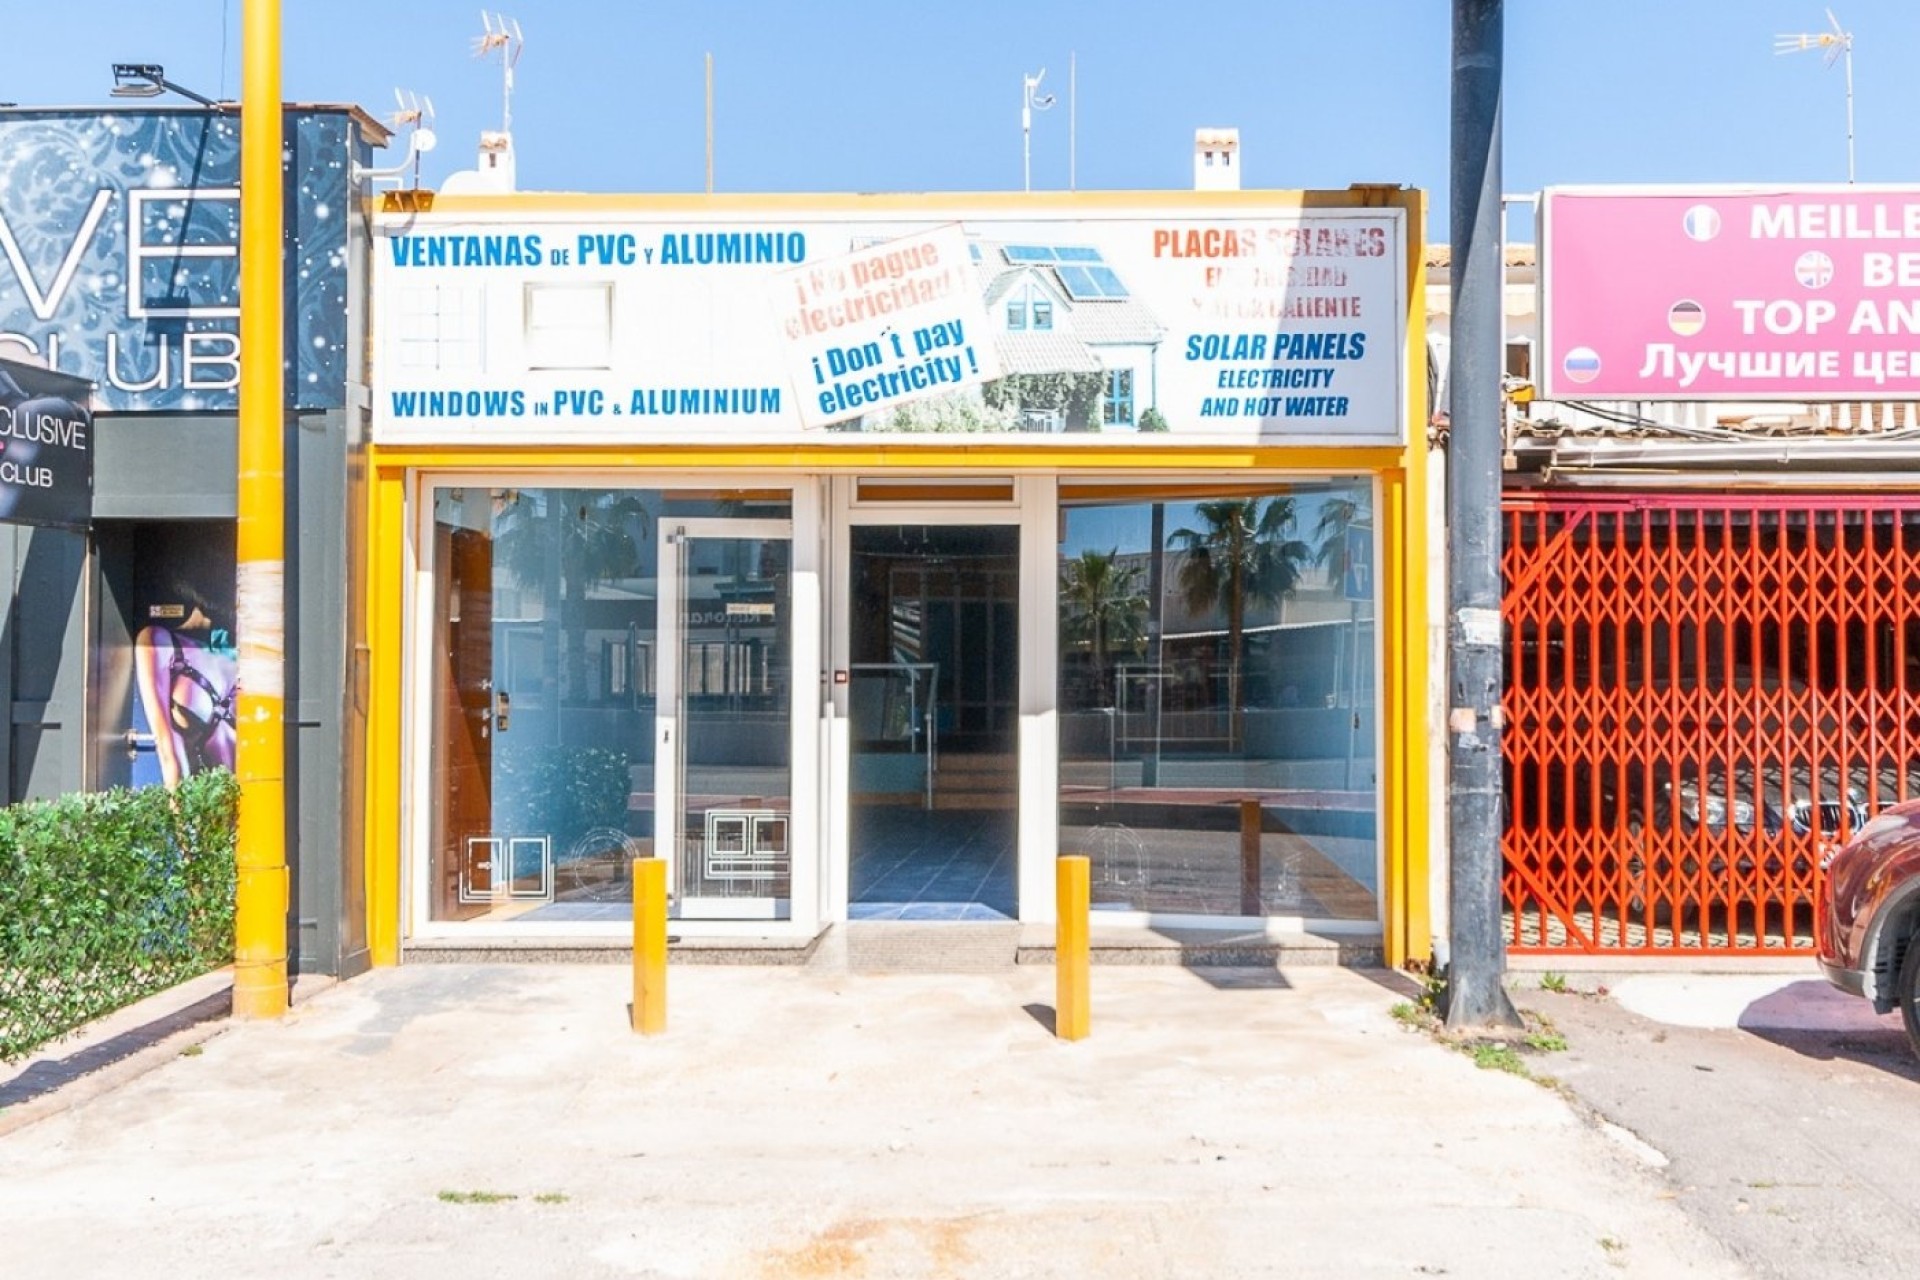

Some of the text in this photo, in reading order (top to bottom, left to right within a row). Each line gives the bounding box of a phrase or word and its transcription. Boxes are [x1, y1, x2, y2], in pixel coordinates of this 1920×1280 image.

[1750, 204, 1920, 238] MEILLE
[0, 189, 240, 319] VE
[391, 232, 806, 267] VENTANAS DE PVC Y ALUMINIO
[851, 242, 939, 287] pague
[1863, 252, 1920, 287] BE
[1733, 300, 1920, 334] TOP AN
[912, 318, 964, 356] pay
[1185, 333, 1366, 361] SOLAR PANELS
[818, 353, 963, 415] electricity
[1218, 369, 1335, 388] ELECTRICITY
[392, 388, 781, 417] WINDOWS IN PVC & ALUMINIUM
[1200, 397, 1349, 416] AND HOT WATER
[0, 406, 86, 450] CLUSIVE
[0, 462, 53, 488] CLUB
